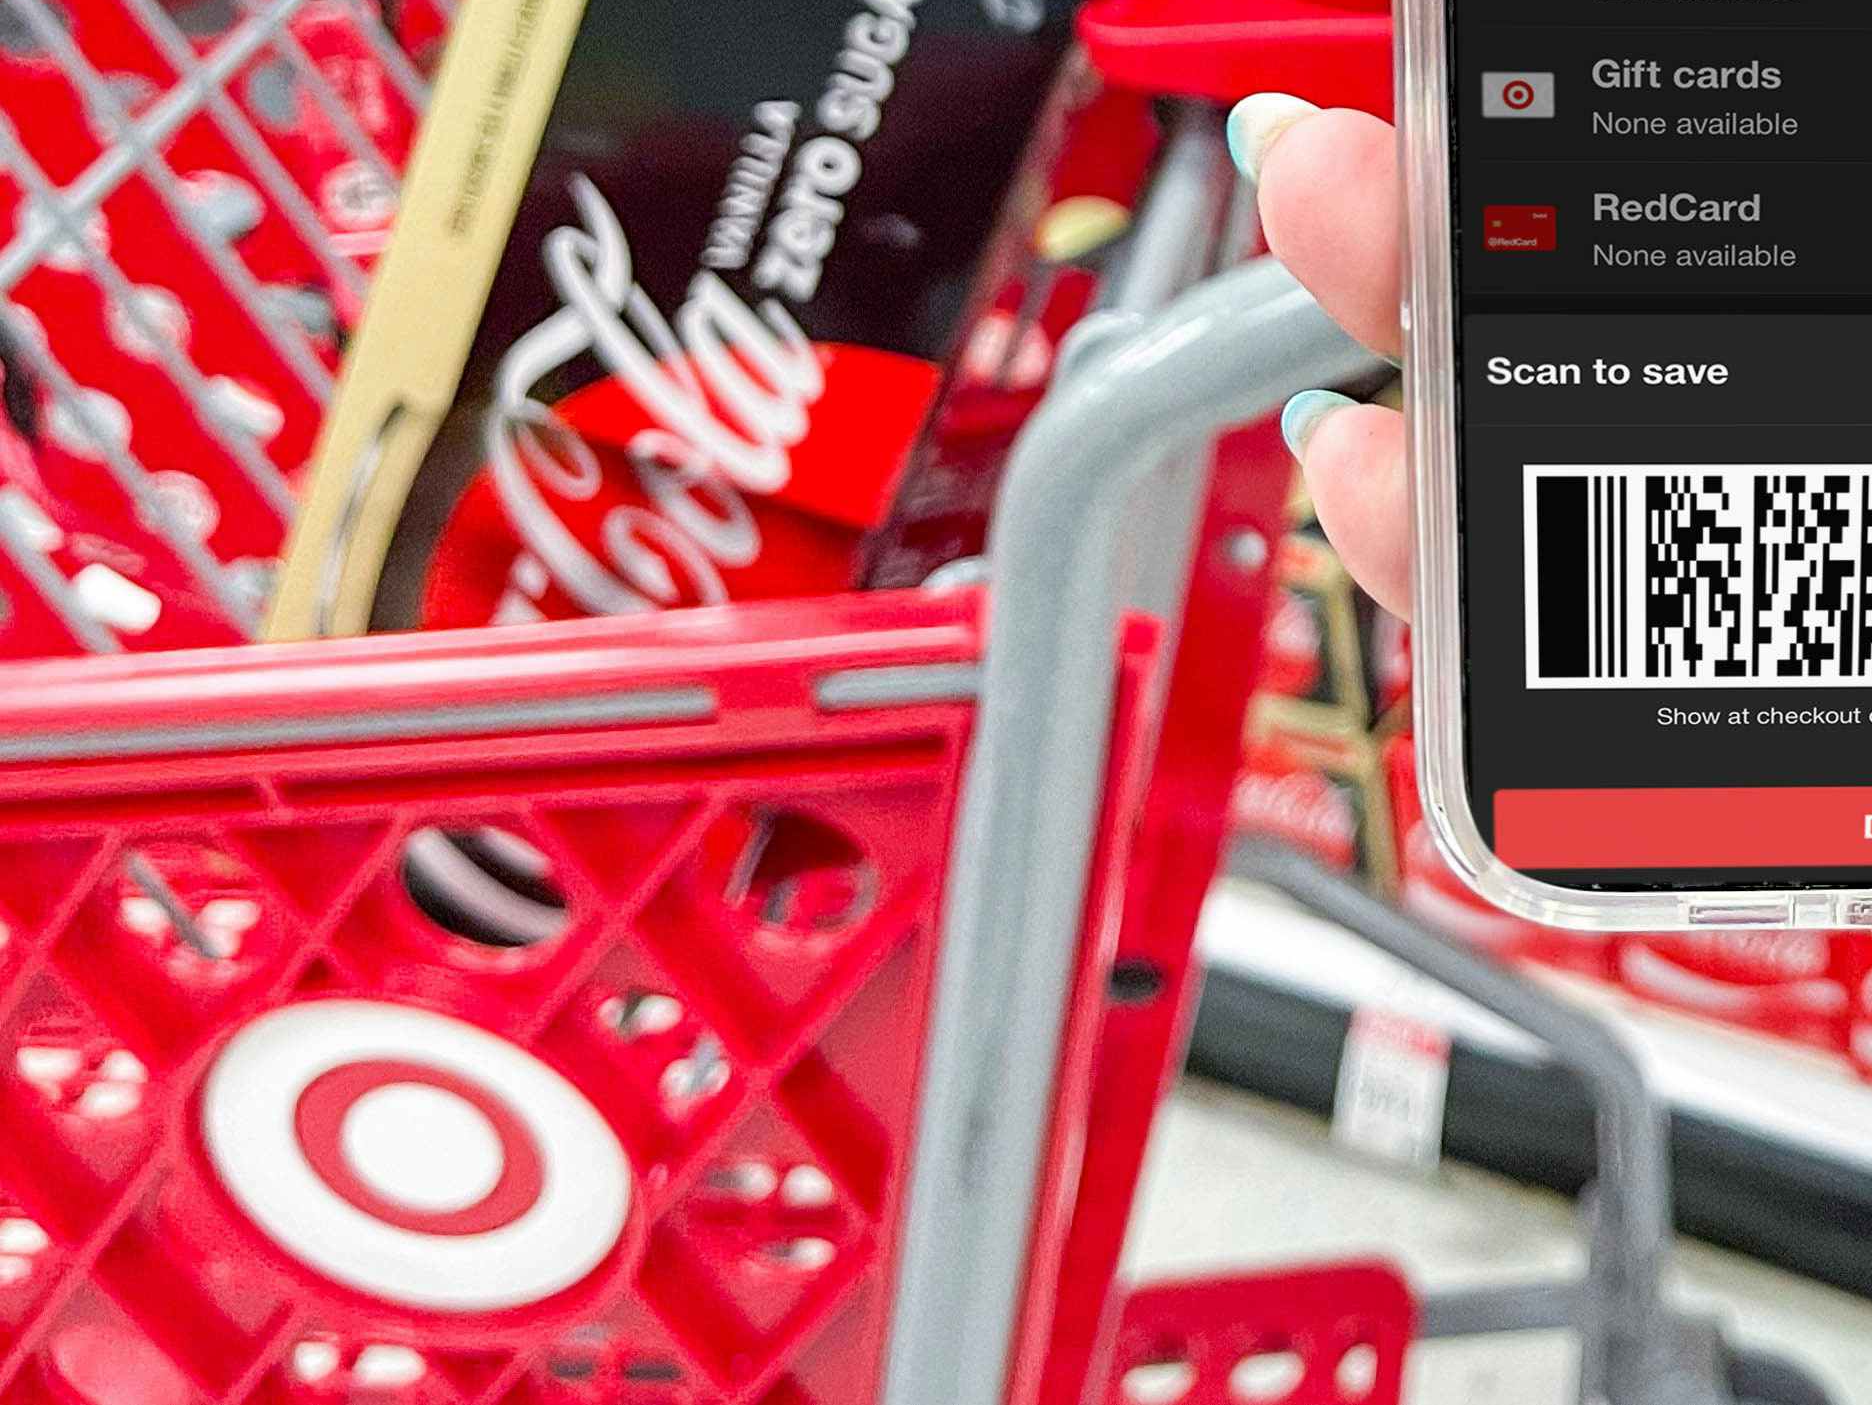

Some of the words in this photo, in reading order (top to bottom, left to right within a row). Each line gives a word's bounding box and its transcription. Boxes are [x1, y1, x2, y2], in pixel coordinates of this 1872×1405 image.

[1592, 59, 1661, 88] Gift
[1674, 60, 1781, 89] cards
[1593, 112, 1666, 134] None
[1677, 113, 1797, 135] available
[1594, 193, 1760, 221] RedCard
[1594, 244, 1666, 266] None
[1676, 245, 1796, 266] available
[1487, 357, 1580, 384] Scan
[1593, 359, 1630, 384] to
[1643, 364, 1728, 384] save
[1658, 708, 1720, 725] Show
[1728, 708, 1749, 724] at
[1757, 707, 1861, 724] checkout
